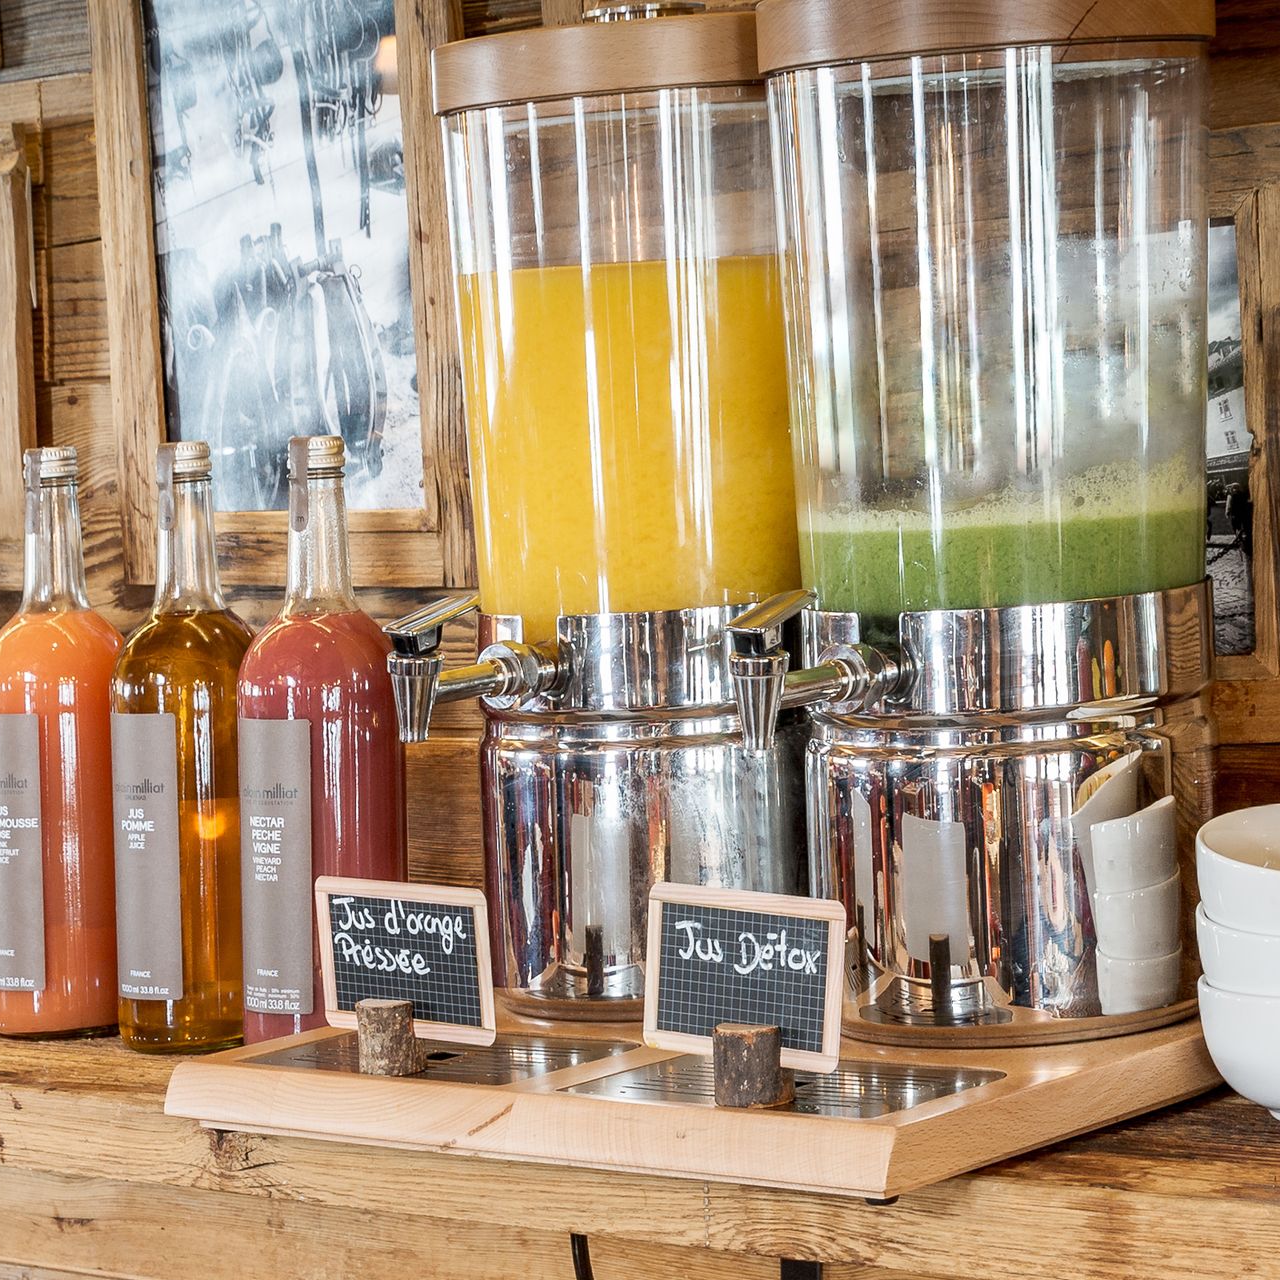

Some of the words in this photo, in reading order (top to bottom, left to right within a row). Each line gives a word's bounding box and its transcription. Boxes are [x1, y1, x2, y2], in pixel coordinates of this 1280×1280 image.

[128, 808, 144, 819] JUS
[122, 820, 155, 831] POMME
[250, 816, 284, 828] NECTAR
[252, 830, 282, 840] PECHE
[253, 842, 280, 853] VIGNE
[253, 856, 281, 865] VINEYARD
[256, 865, 276, 873] PEACH
[255, 873, 278, 882] NECTAR
[332, 897, 375, 930] Jus
[384, 900, 466, 955] d'orange
[675, 920, 723, 962] Jus
[257, 969, 279, 977] FRANCE
[140, 986, 153, 994] 33.8
[268, 999, 283, 1009] 33.8
